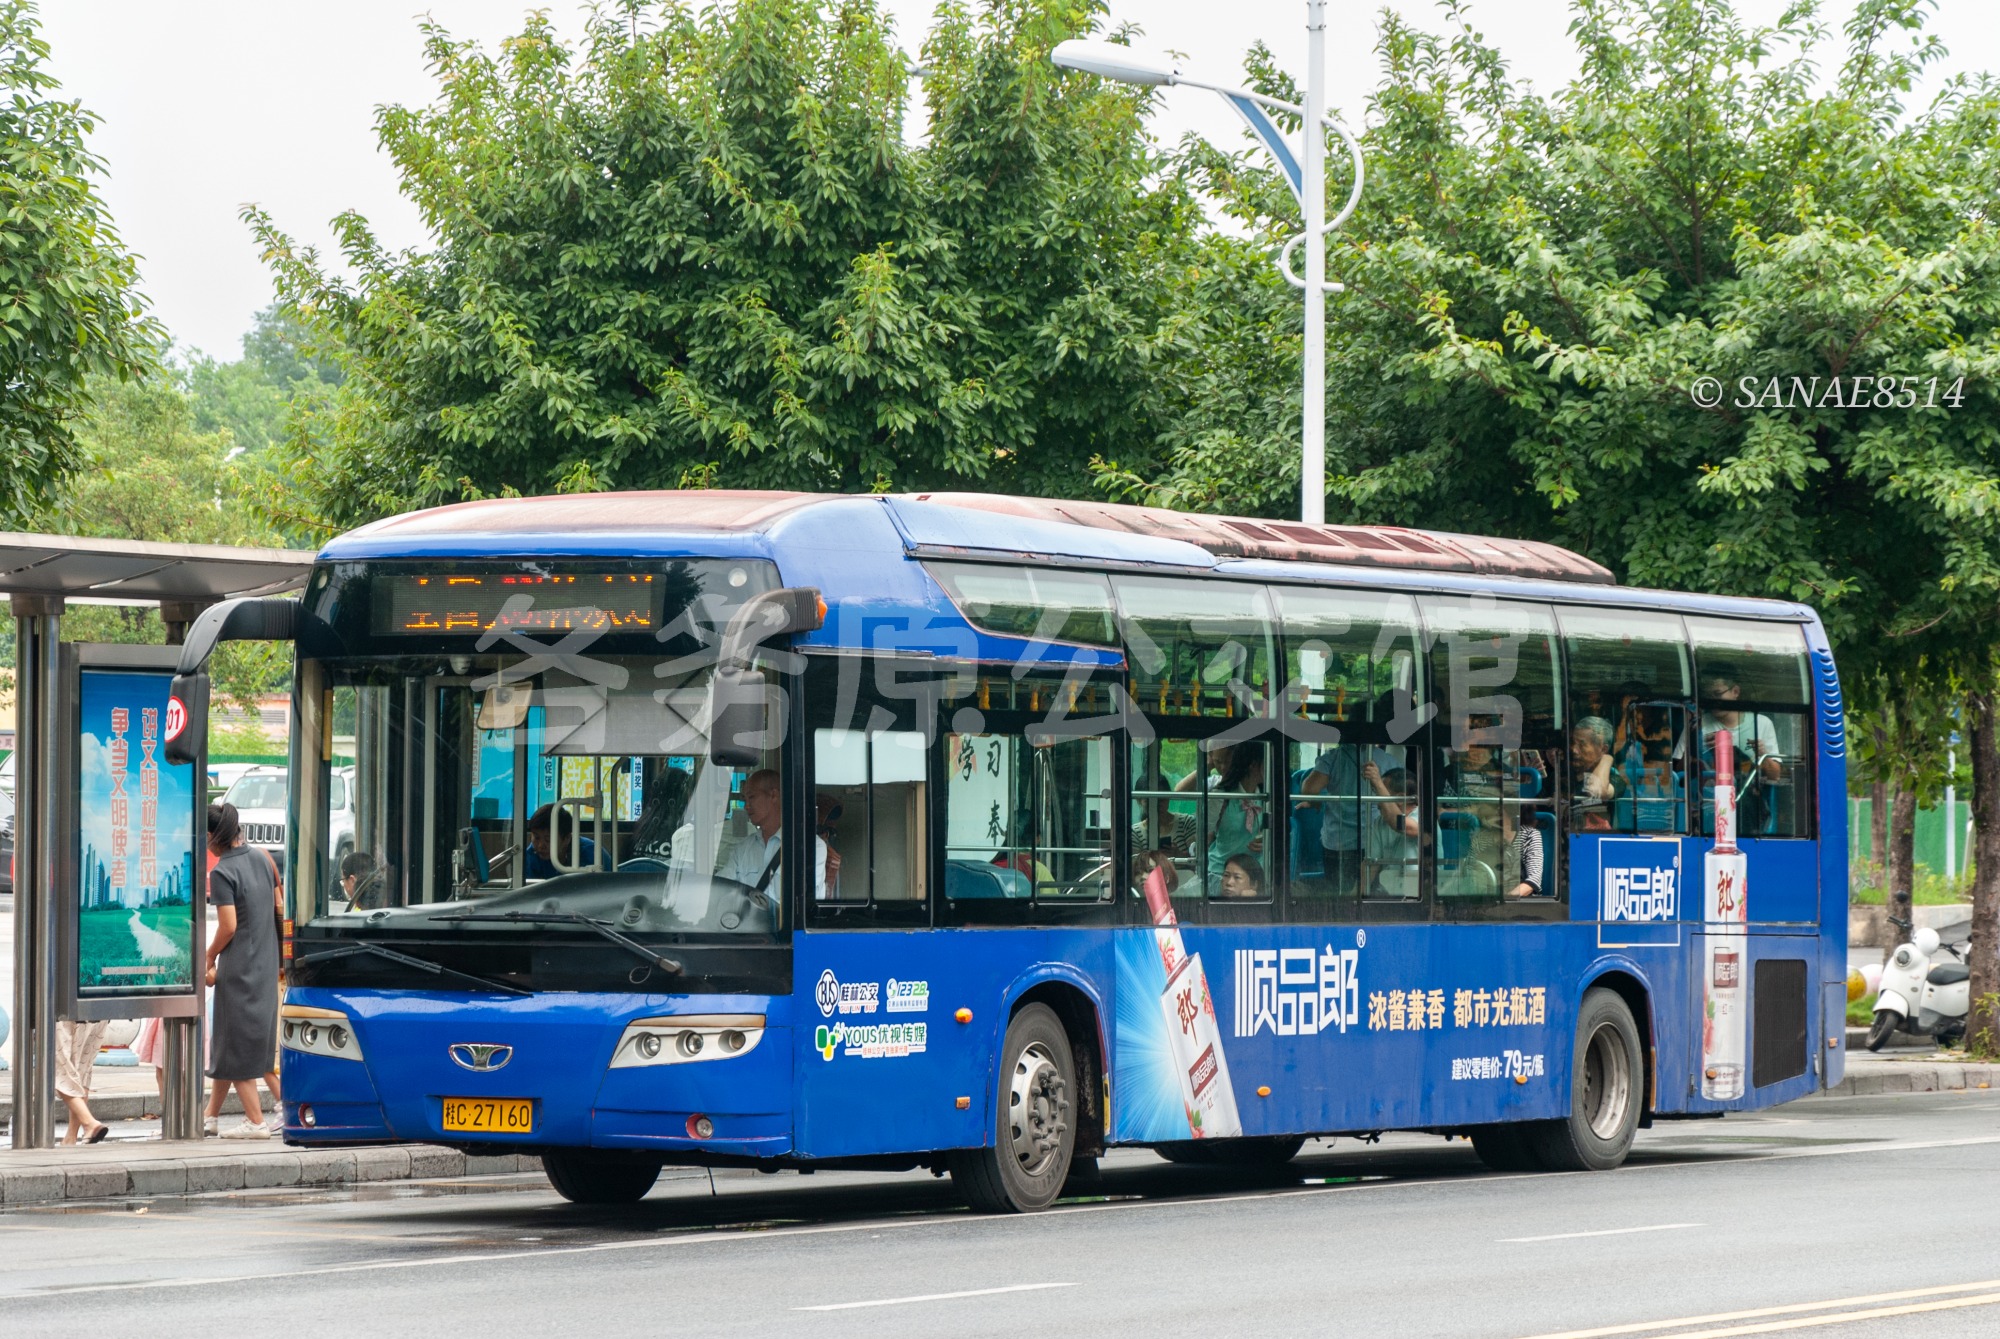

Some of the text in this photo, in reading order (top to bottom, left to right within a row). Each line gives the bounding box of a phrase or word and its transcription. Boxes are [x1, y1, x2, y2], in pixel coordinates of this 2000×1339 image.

[166, 708, 181, 731] 01
[110, 706, 130, 888] 争当文明使者
[140, 707, 159, 888] 讲文明树新风
[1604, 866, 1674, 921] 顺品郎
[841, 984, 878, 1001] 桂林公交
[897, 983, 927, 997] 12328
[1235, 943, 1359, 1037] 顺品郎
[1367, 986, 1546, 1032] 浓酱兼香 都市光瓶酒
[845, 1026, 926, 1044] YOUS优视传媒
